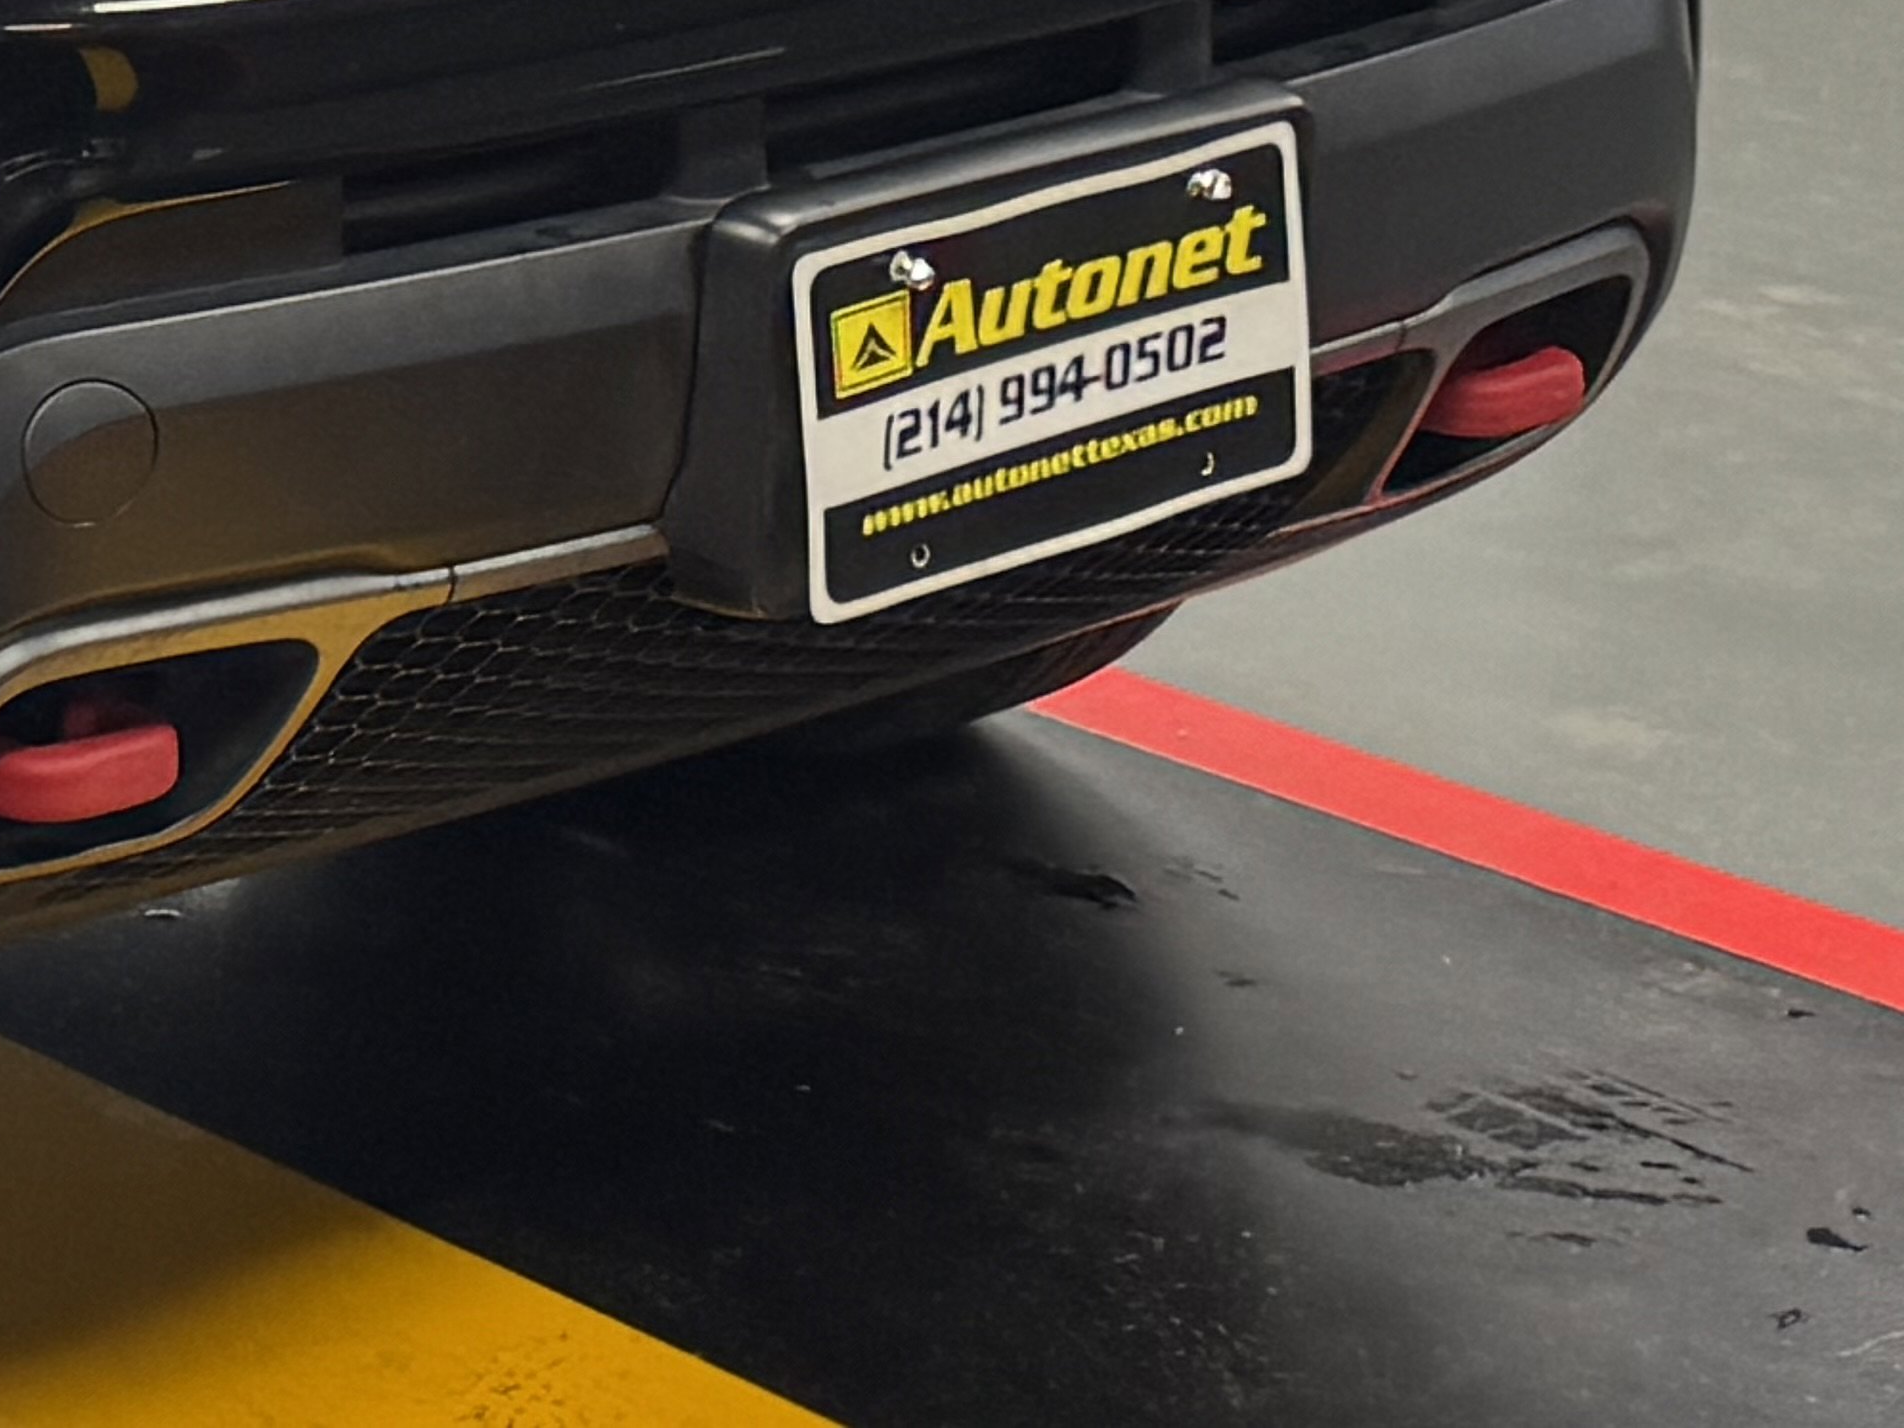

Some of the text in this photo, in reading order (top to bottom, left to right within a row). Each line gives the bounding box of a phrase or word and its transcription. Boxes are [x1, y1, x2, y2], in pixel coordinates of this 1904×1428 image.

[914, 204, 1267, 369] Autonet
[862, 394, 1259, 537] www.autonettexas.com
[882, 315, 1228, 472] (214) 994-0502
